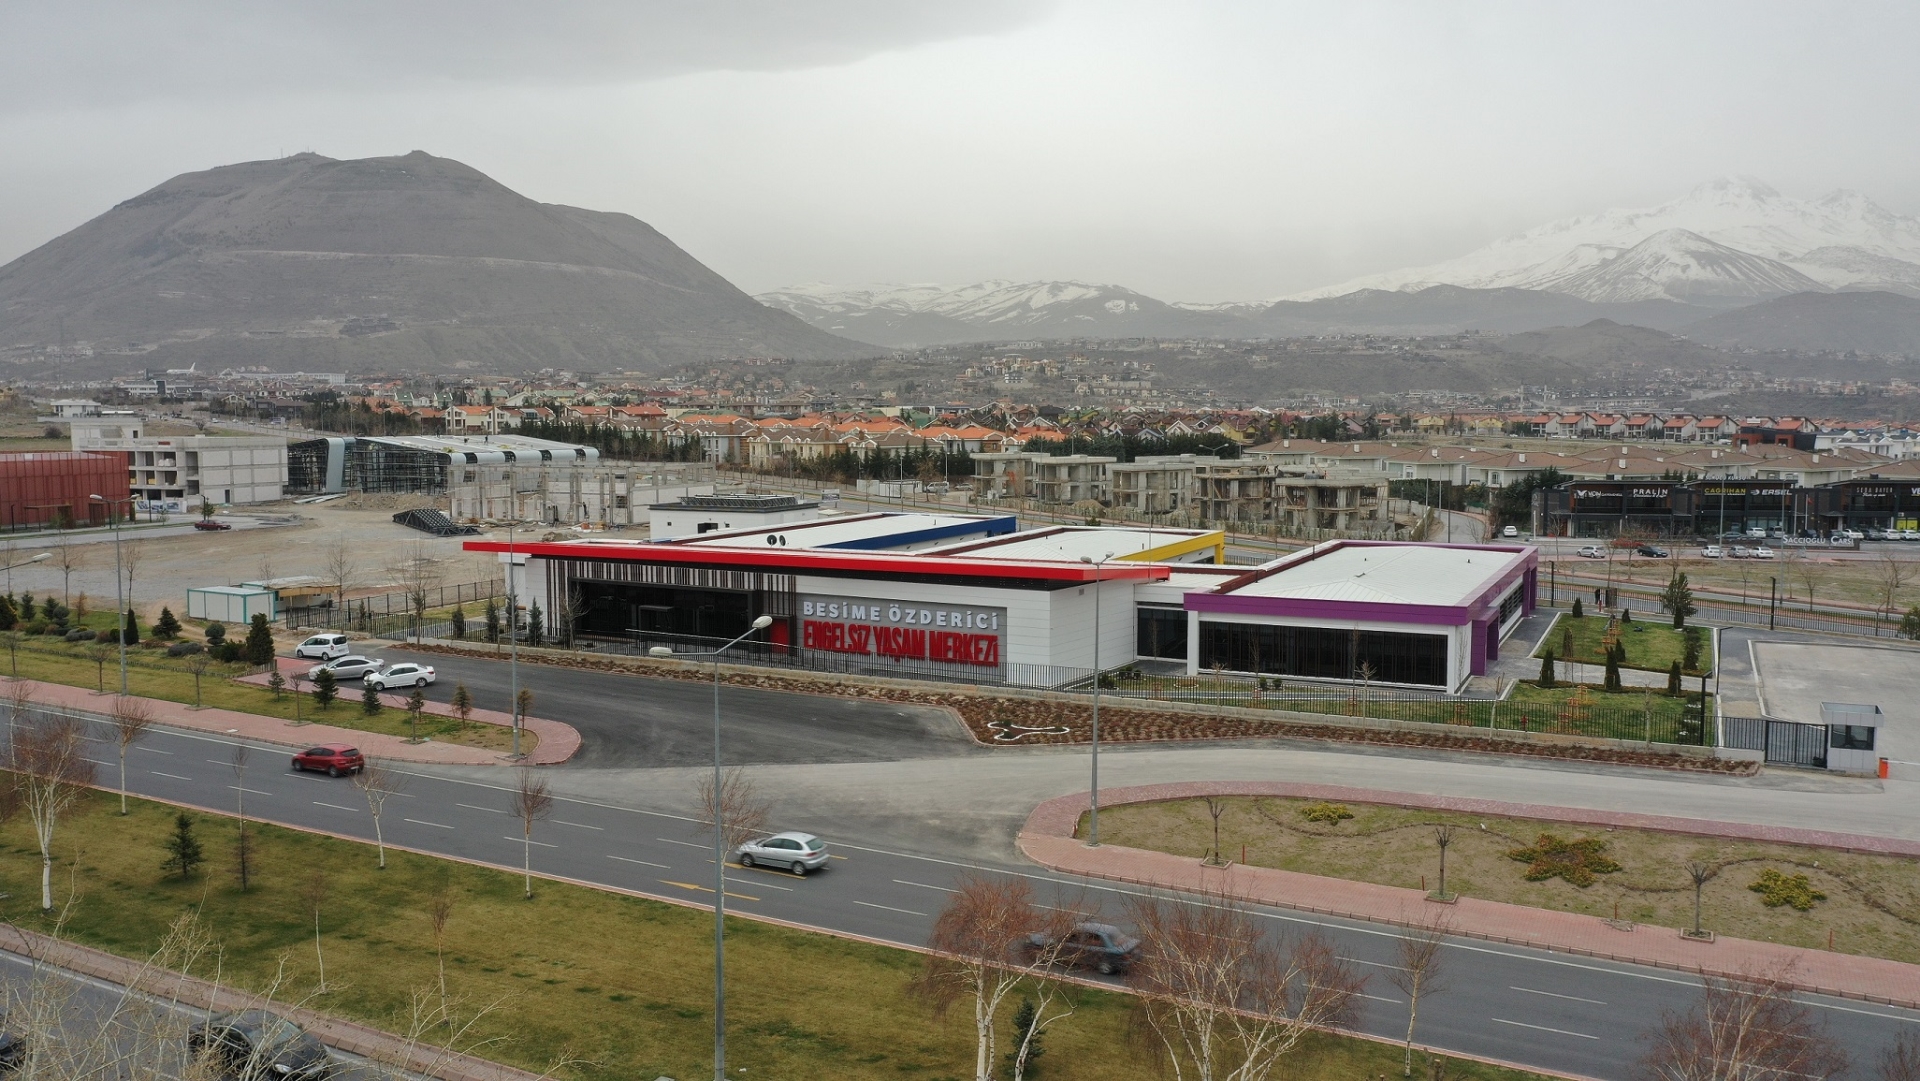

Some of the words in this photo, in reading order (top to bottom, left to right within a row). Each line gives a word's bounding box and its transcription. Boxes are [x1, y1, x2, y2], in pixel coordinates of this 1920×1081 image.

[803, 601, 881, 621] BESİME
[888, 603, 998, 630] ÖZDERİCİ
[803, 619, 871, 655] ENGELSİZ
[873, 626, 926, 662] YAŞAM
[929, 630, 999, 668] MERKEZİ
